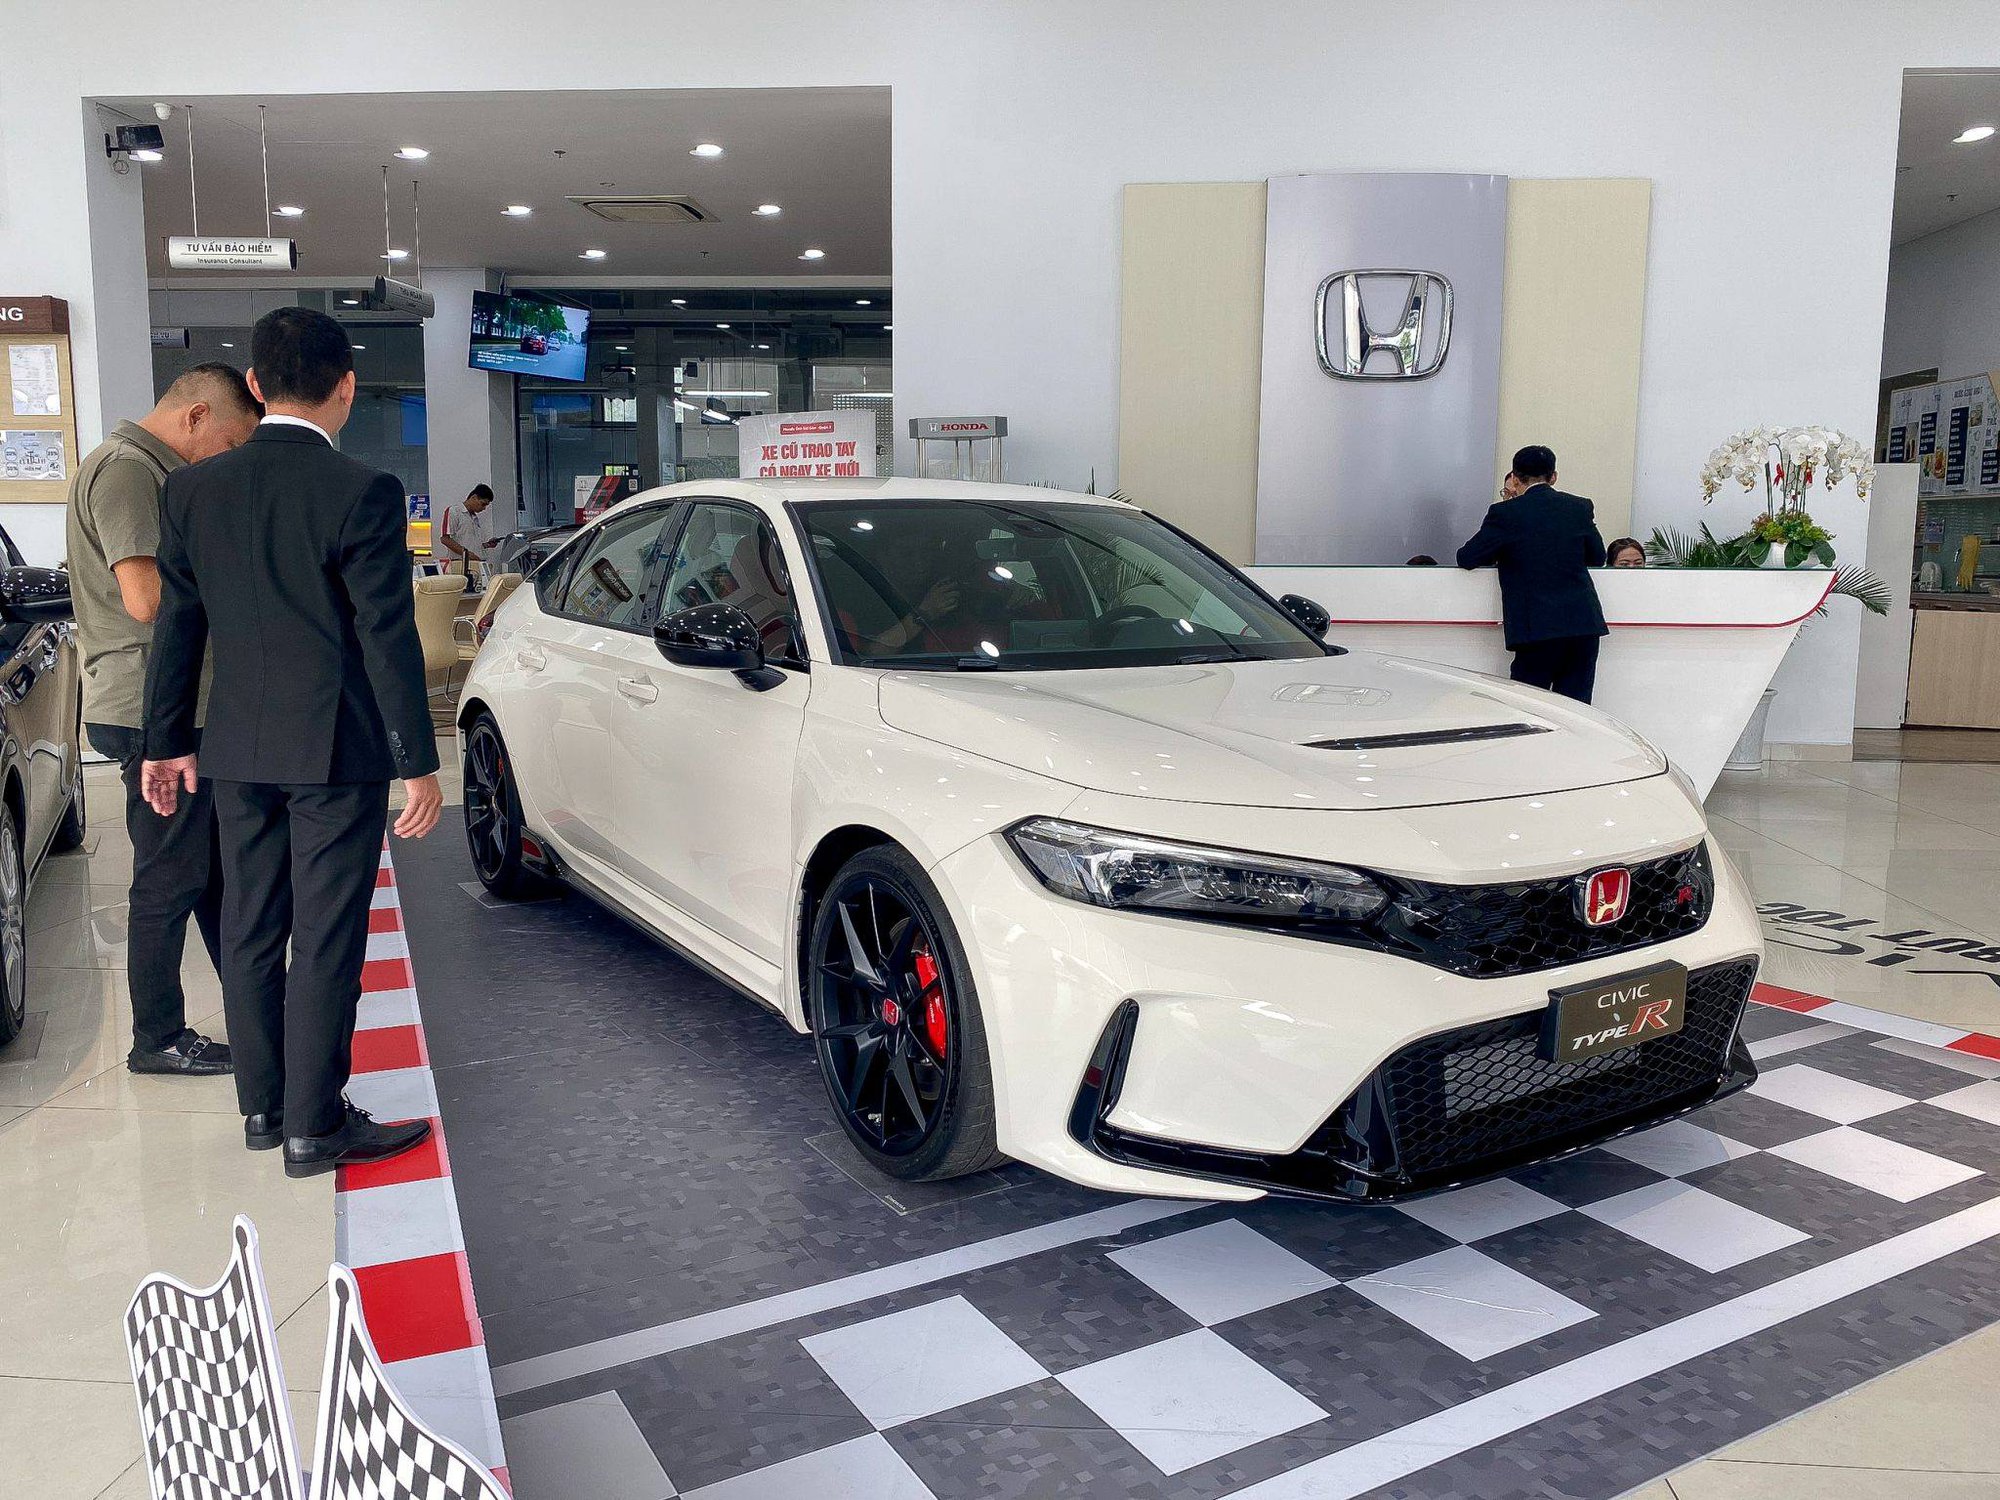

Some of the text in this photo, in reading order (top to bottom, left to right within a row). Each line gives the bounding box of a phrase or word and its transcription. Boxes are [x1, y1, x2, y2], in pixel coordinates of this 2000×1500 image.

[187, 240, 272, 253] TƯ VẤN BẢO HIỂM
[940, 423, 989, 431] HONDA
[762, 441, 856, 460] XE CŨ TRAO TAY
[1597, 983, 1651, 1009] CIVIC
[1572, 998, 1673, 1050] TYPE R
